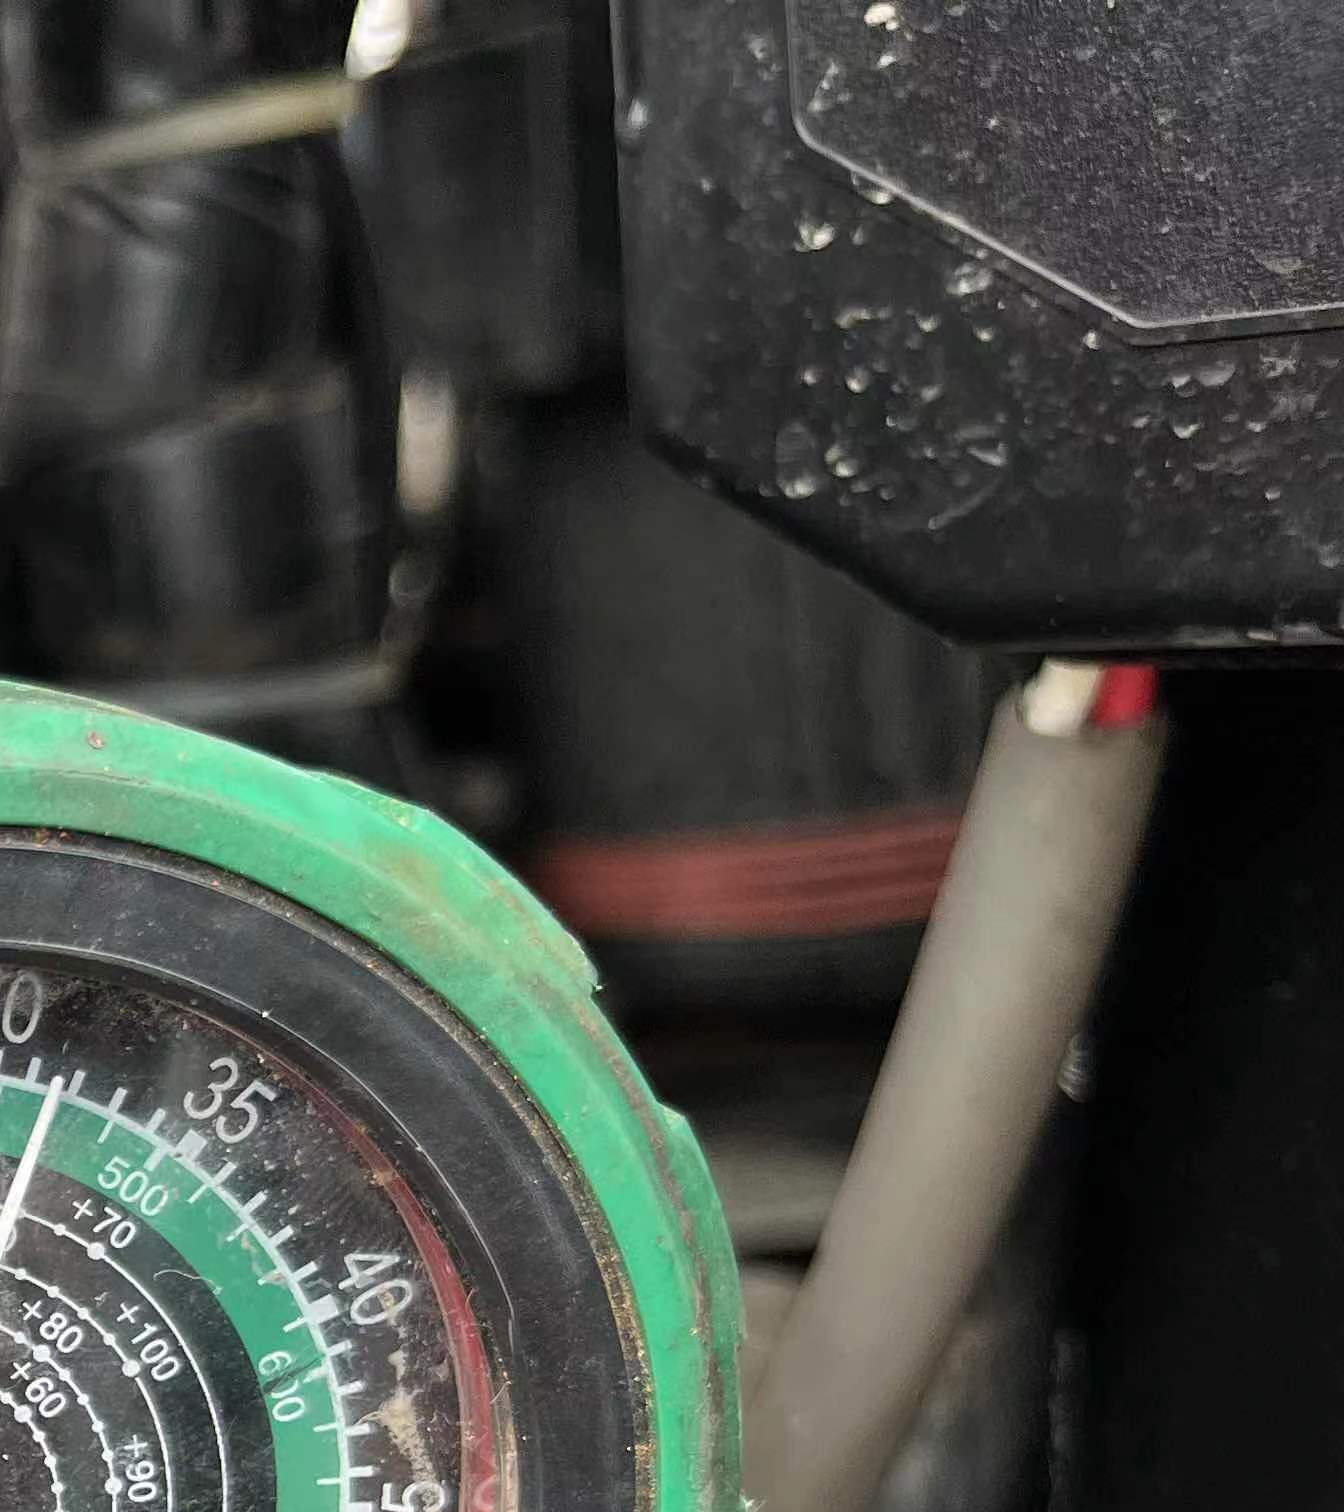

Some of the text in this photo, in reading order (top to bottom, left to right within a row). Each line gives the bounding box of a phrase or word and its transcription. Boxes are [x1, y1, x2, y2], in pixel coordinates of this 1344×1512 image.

[183, 1057, 278, 1144] 35
[97, 1156, 169, 1217] 500
[72, 1199, 137, 1249] +70
[338, 1252, 413, 1326] 40
[21, 1299, 83, 1354] +80
[116, 1302, 181, 1382] +100
[10, 1361, 66, 1418] +60
[123, 1434, 158, 1503] +90
